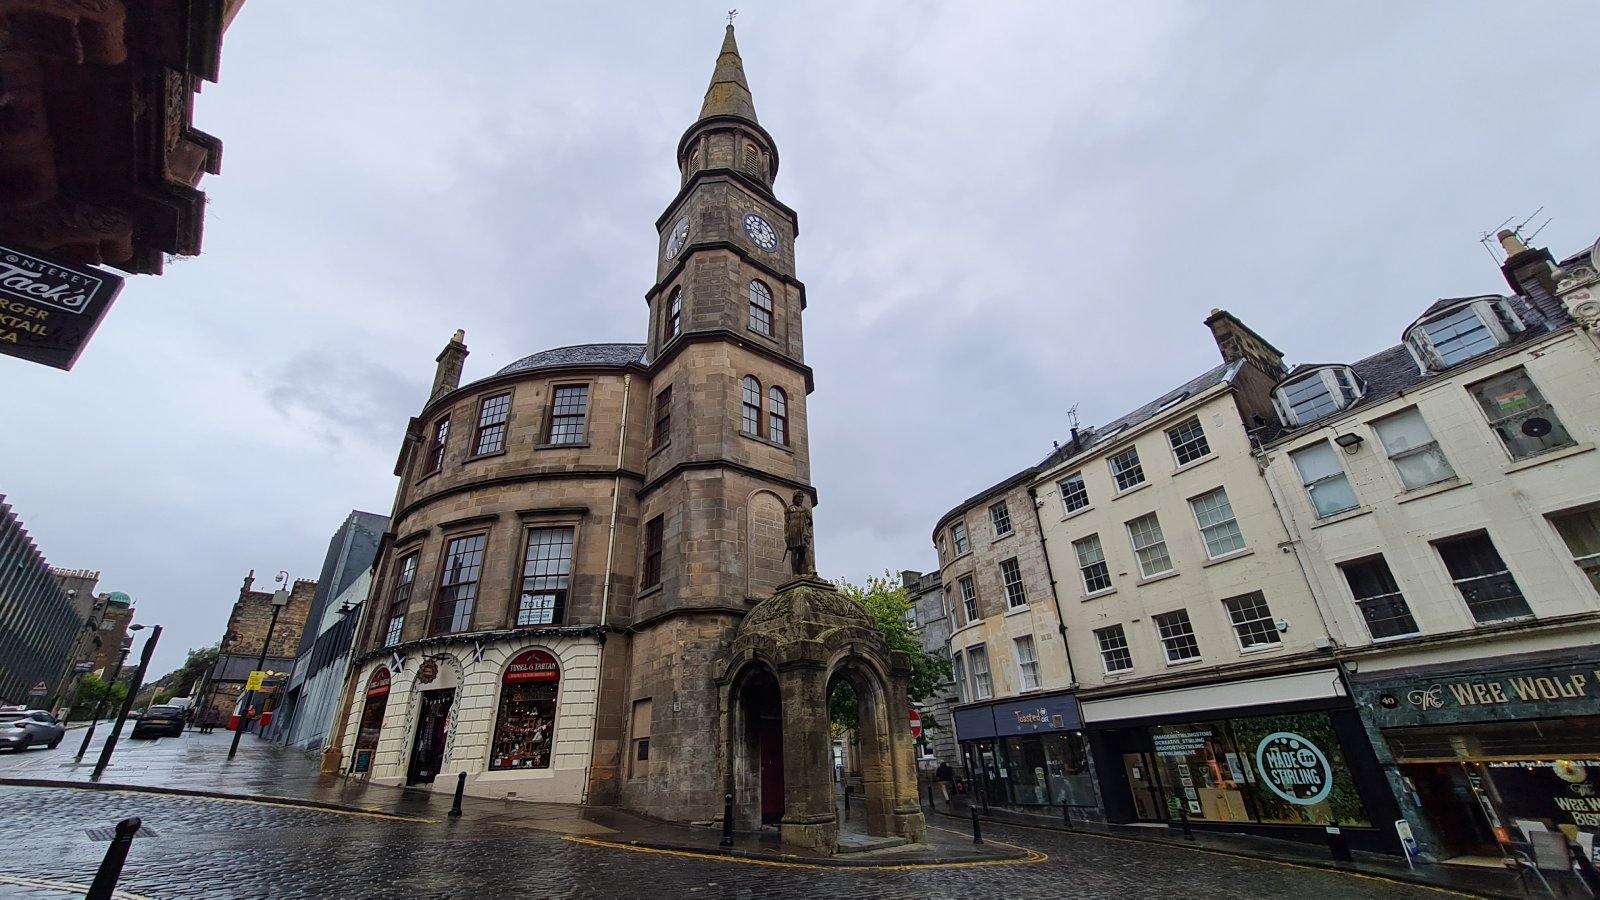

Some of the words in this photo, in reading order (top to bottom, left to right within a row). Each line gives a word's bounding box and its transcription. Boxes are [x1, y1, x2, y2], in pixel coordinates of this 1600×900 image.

[0, 252, 92, 286] ONTEREY
[1382, 696, 1394, 705] 40
[1449, 682, 1508, 706] WEE
[1014, 709, 1040, 723] Toasted
[1266, 752, 1299, 768] MADE
[1299, 752, 1314, 763] in
[1271, 768, 1321, 785] STIRLING
